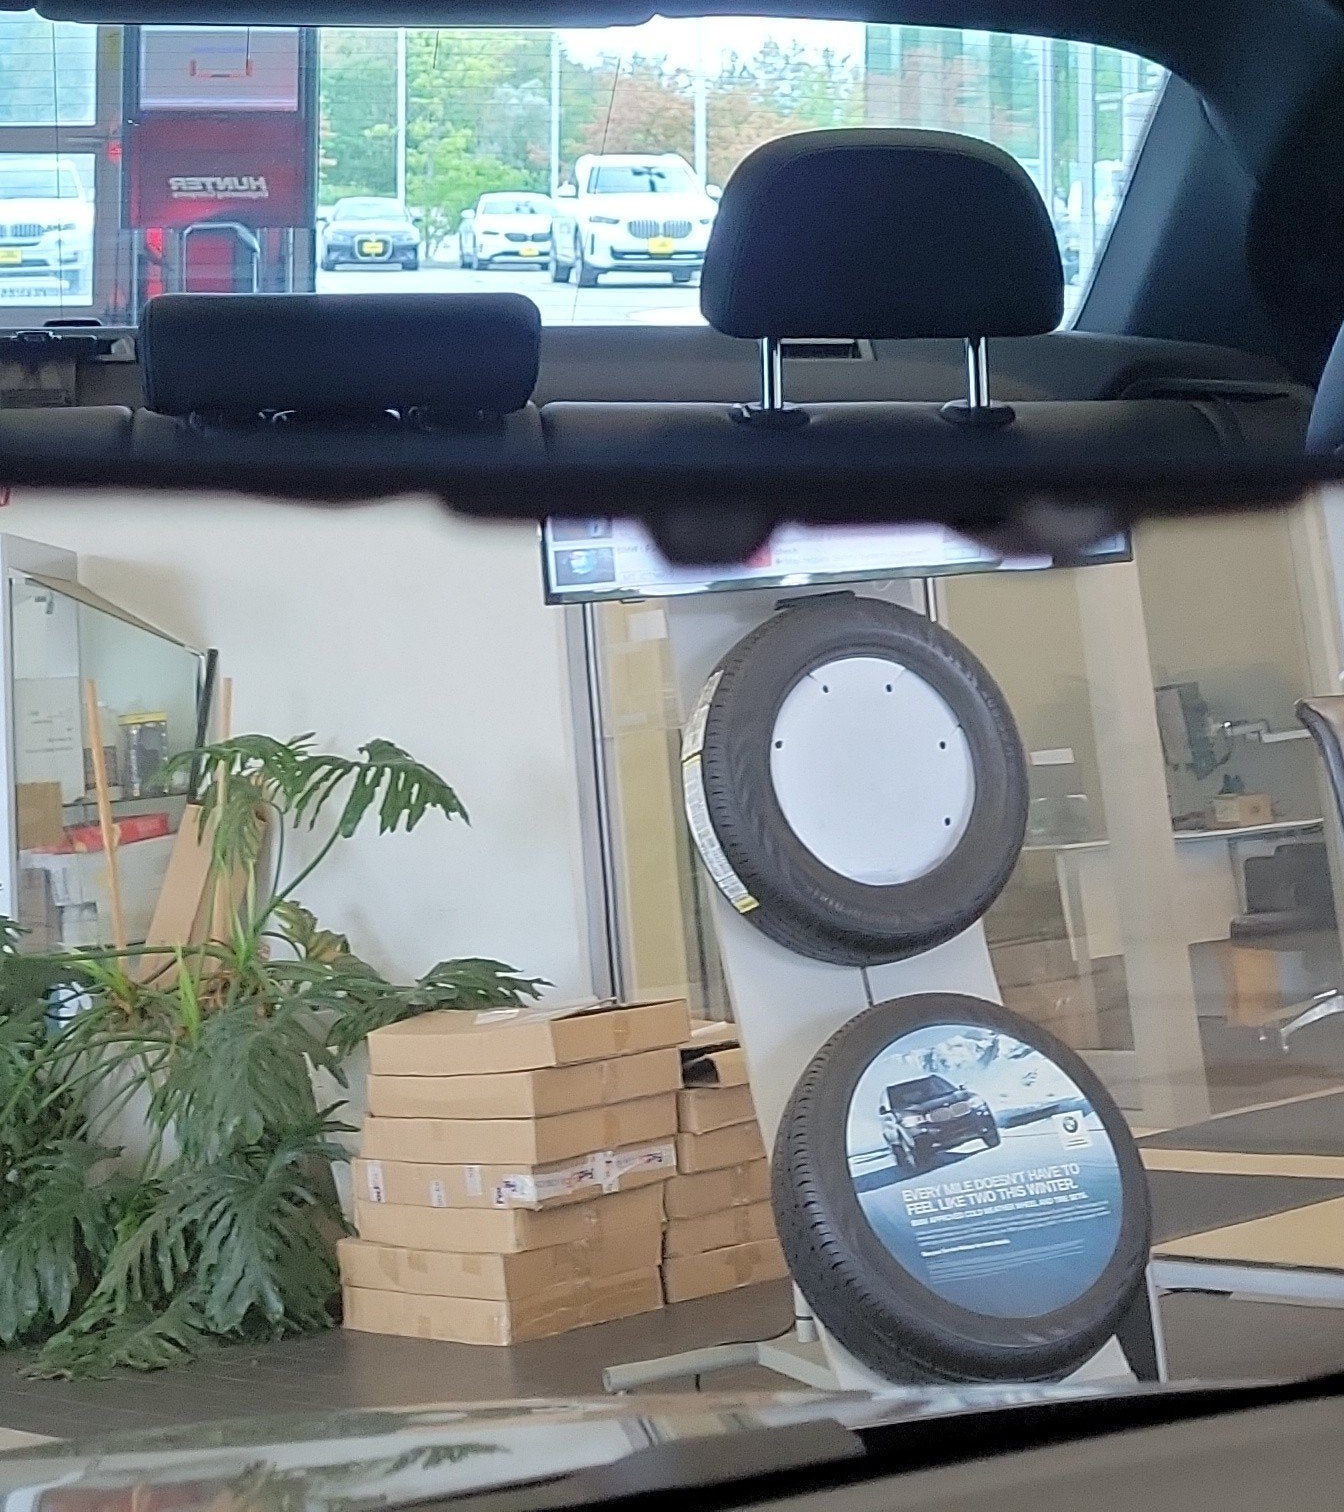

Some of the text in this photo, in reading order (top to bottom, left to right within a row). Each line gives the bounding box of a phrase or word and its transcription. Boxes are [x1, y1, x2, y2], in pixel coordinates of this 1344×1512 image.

[902, 1163, 1080, 1202] EVERY MILE DOESN'T HAVE TO
[906, 1177, 1079, 1216] FEEL LIKE TWO THIS WINTER.
